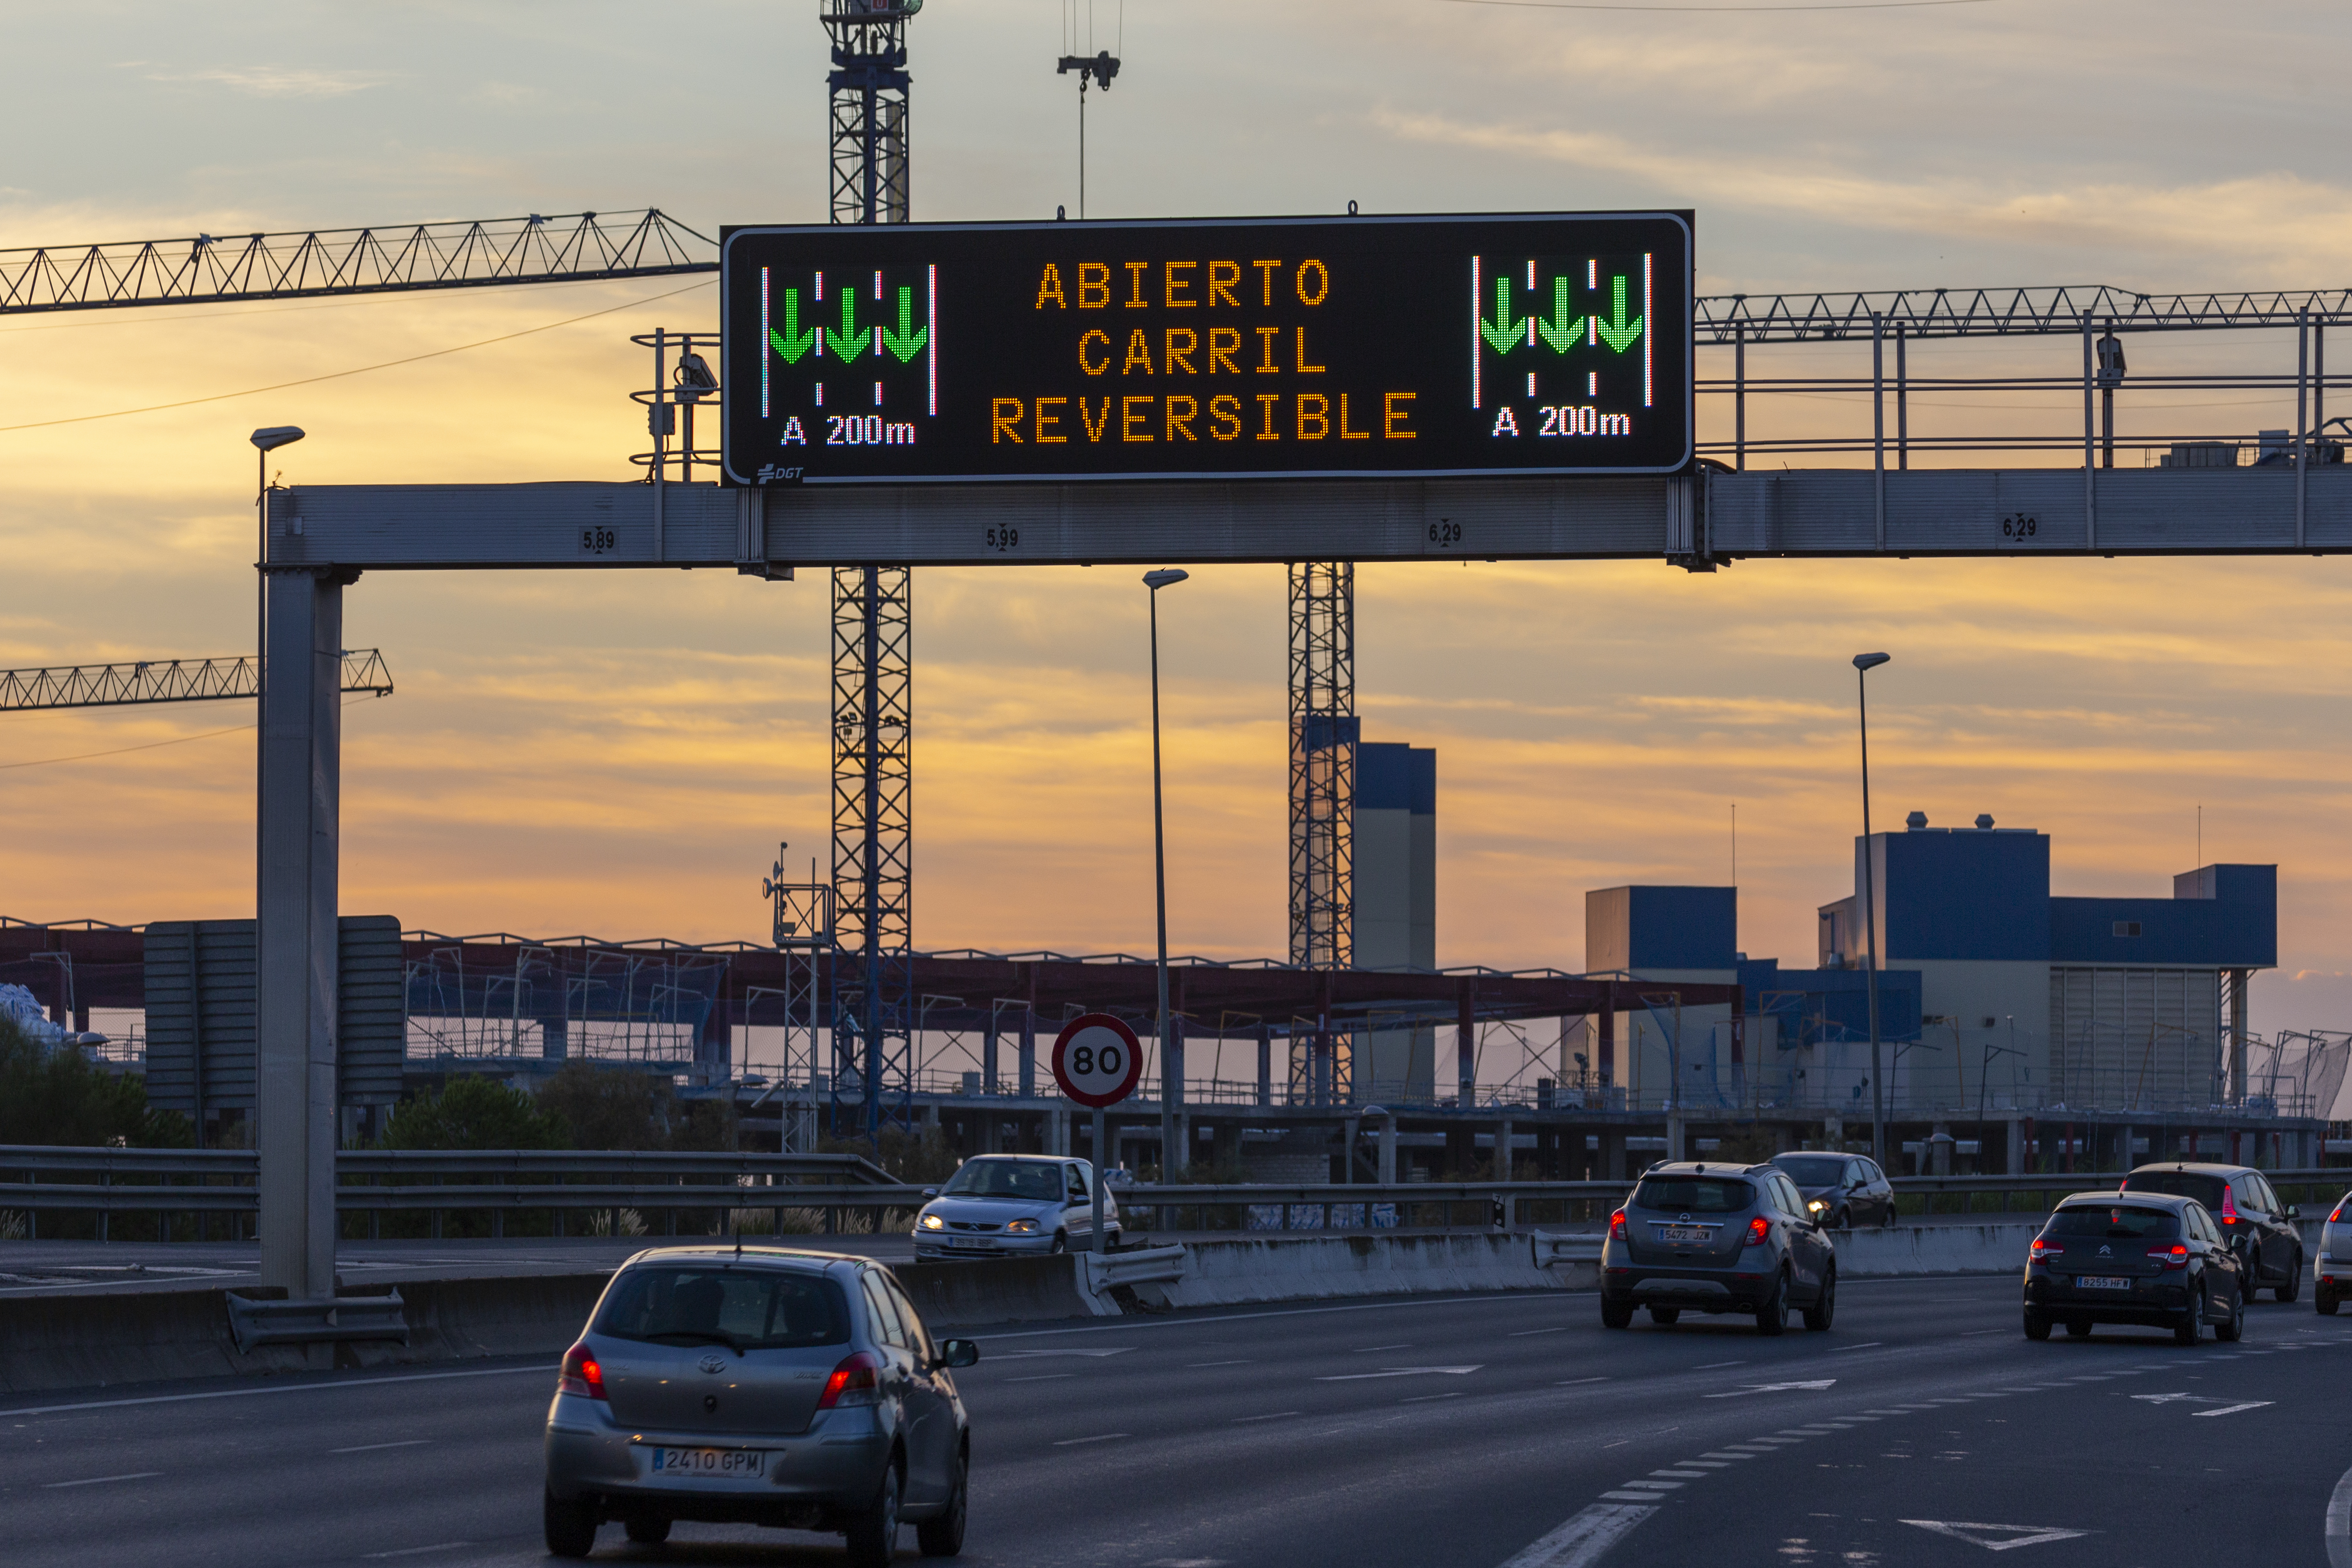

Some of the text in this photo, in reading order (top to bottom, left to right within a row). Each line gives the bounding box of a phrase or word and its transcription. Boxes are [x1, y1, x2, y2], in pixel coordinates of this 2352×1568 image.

[1035, 259, 1328, 309] ABIERTO
[1079, 327, 1325, 375] CARRIL
[992, 393, 1416, 443] REVERSIBLE
[1493, 405, 1630, 437] A 200m
[781, 415, 915, 446] A 200m
[775, 467, 804, 479] DGT
[1429, 523, 1461, 543] 6,29
[2003, 517, 2036, 537] 6,29
[584, 531, 614, 550] 5,89
[987, 528, 1018, 548] 5,99
[1073, 1046, 1121, 1075] 80
[1665, 1230, 1687, 1240] 5472
[2083, 1278, 2107, 1287] 8255
[667, 1450, 758, 1471] 2410 GPM
